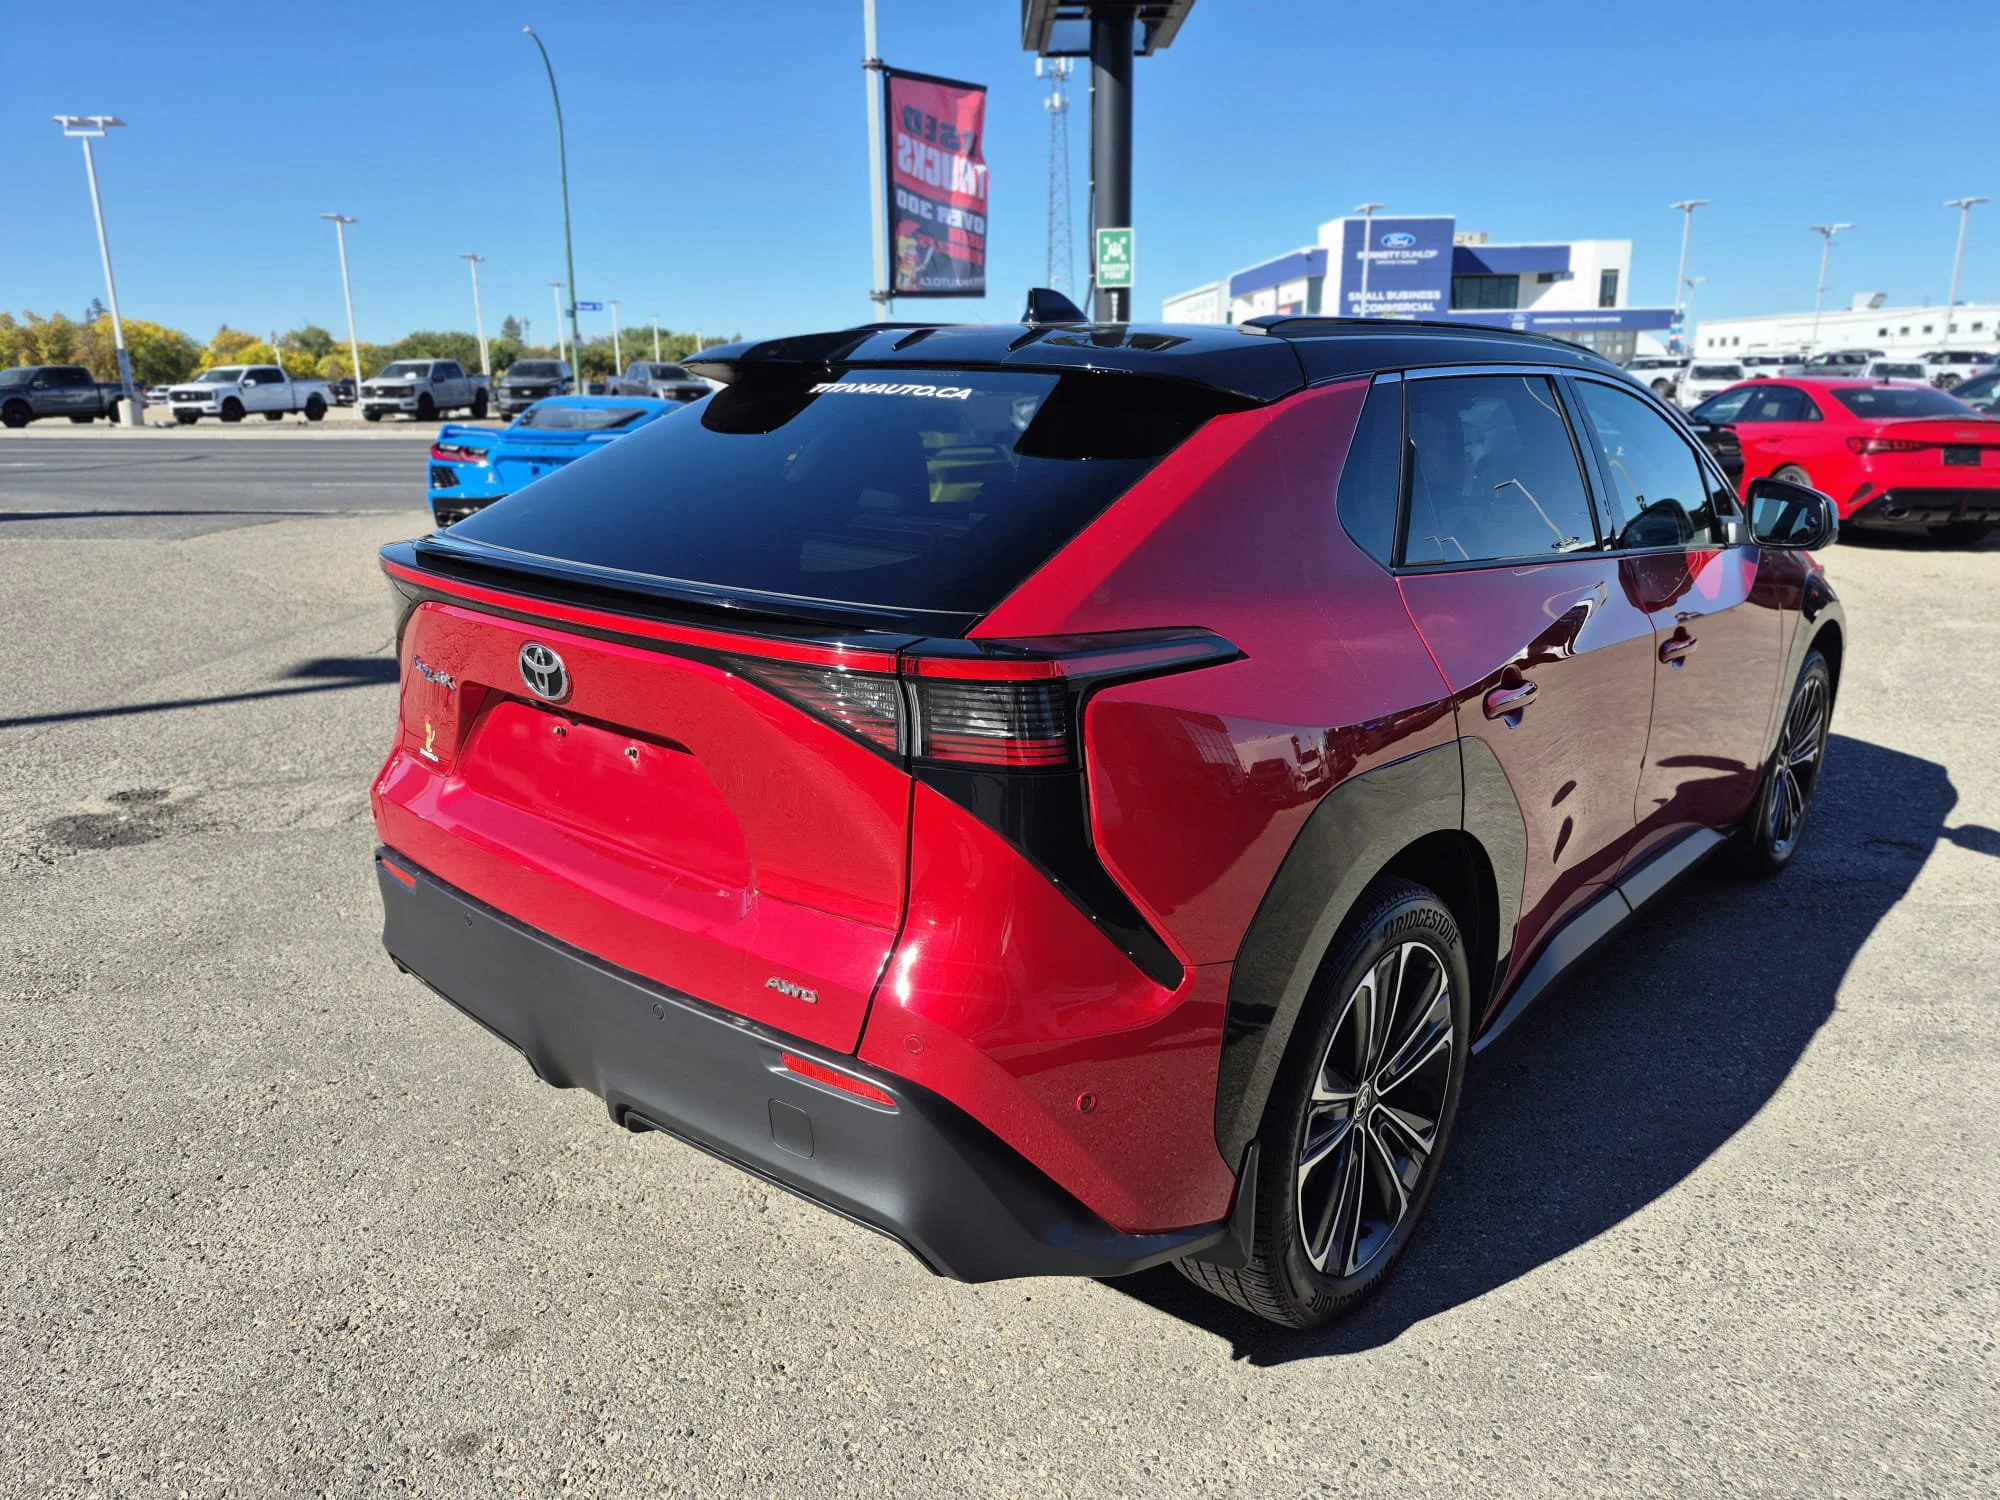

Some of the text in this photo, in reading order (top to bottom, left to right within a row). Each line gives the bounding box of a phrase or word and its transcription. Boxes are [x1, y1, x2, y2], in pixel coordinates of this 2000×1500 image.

[808, 382, 973, 400] TITANAUTO.CA
[1382, 907, 1459, 950] BRIDGESTONE
[765, 976, 819, 1004] AWD
